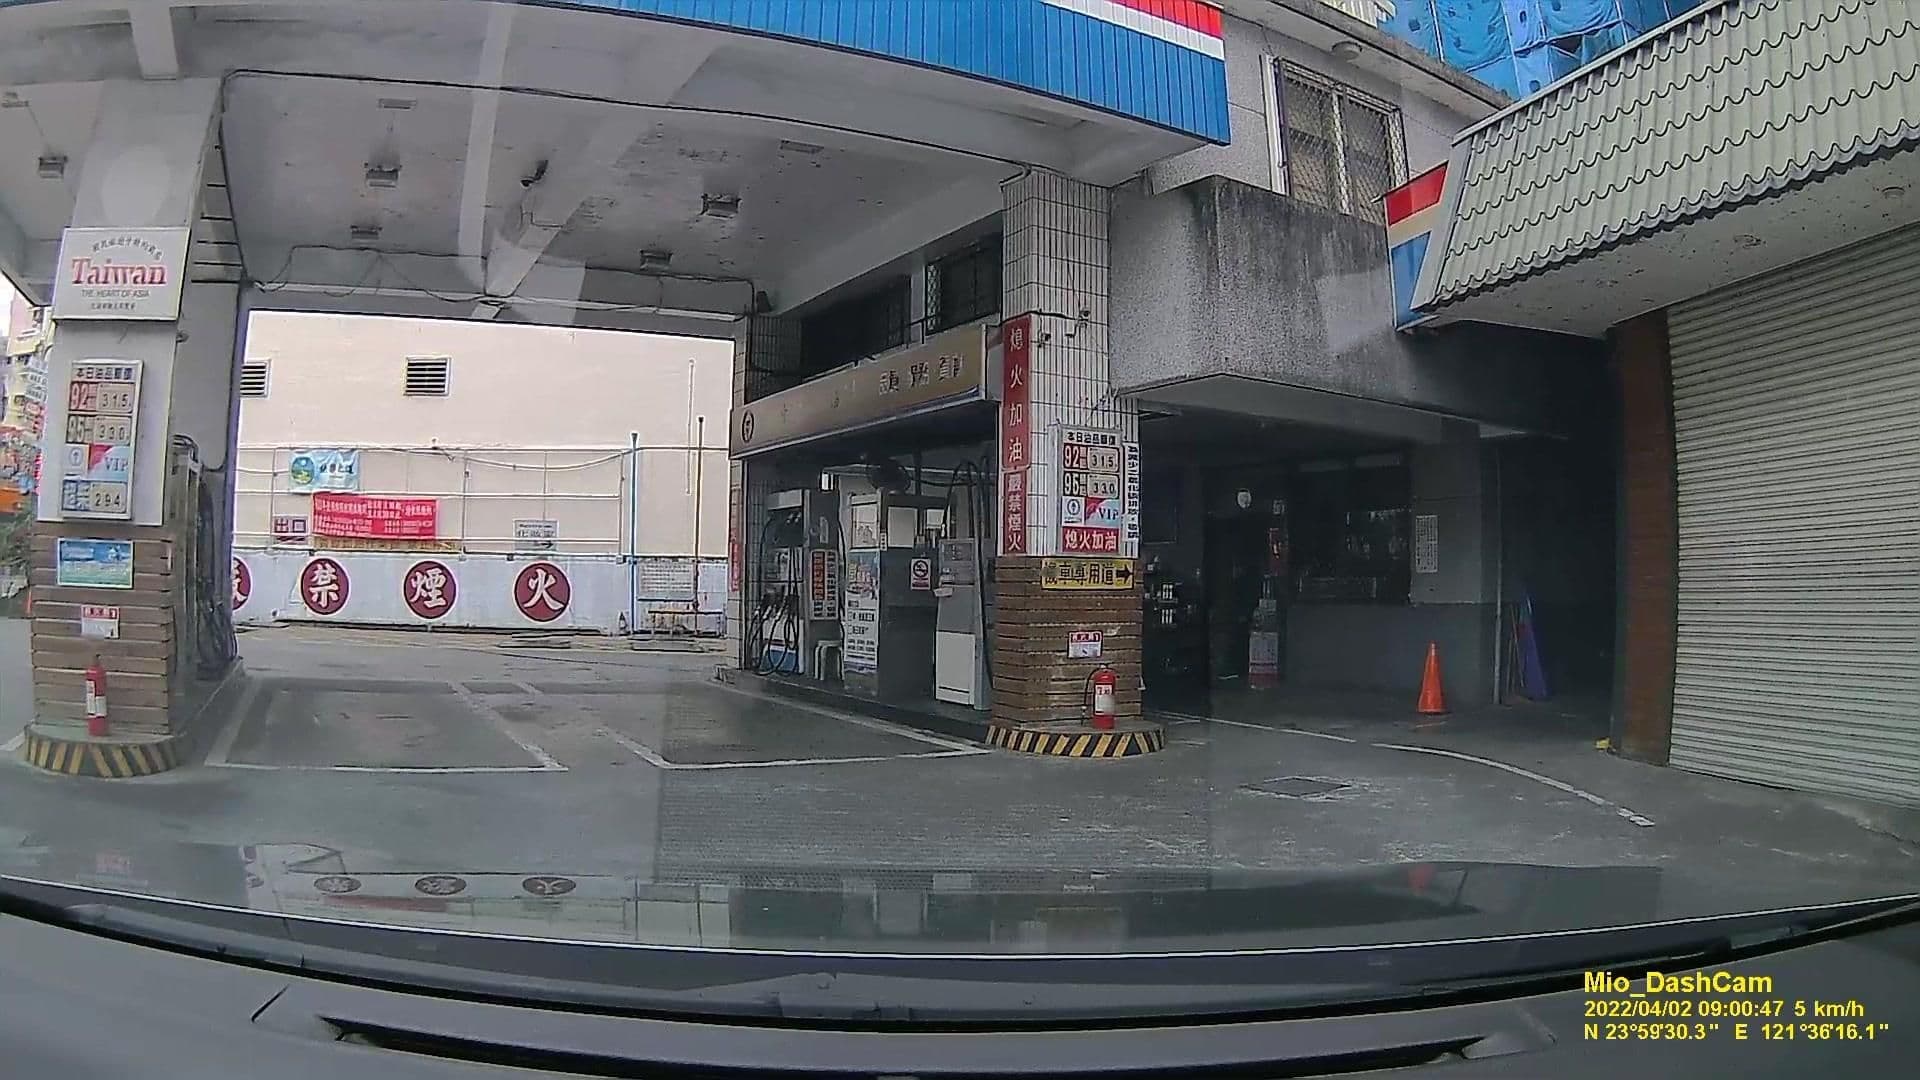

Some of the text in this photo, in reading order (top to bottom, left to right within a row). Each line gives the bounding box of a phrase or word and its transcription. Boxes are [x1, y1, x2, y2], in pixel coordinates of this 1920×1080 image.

[72, 257, 166, 285] Taiwan
[71, 383, 89, 410] 92
[1009, 328, 1023, 463] 熄火加油
[105, 456, 129, 472] VIP
[1064, 445, 1081, 468] 92
[1064, 472, 1081, 495] 95
[1008, 474, 1022, 551] 嚴禁煙火
[1098, 507, 1119, 520] VIP
[1065, 530, 1117, 551] 熄火加油
